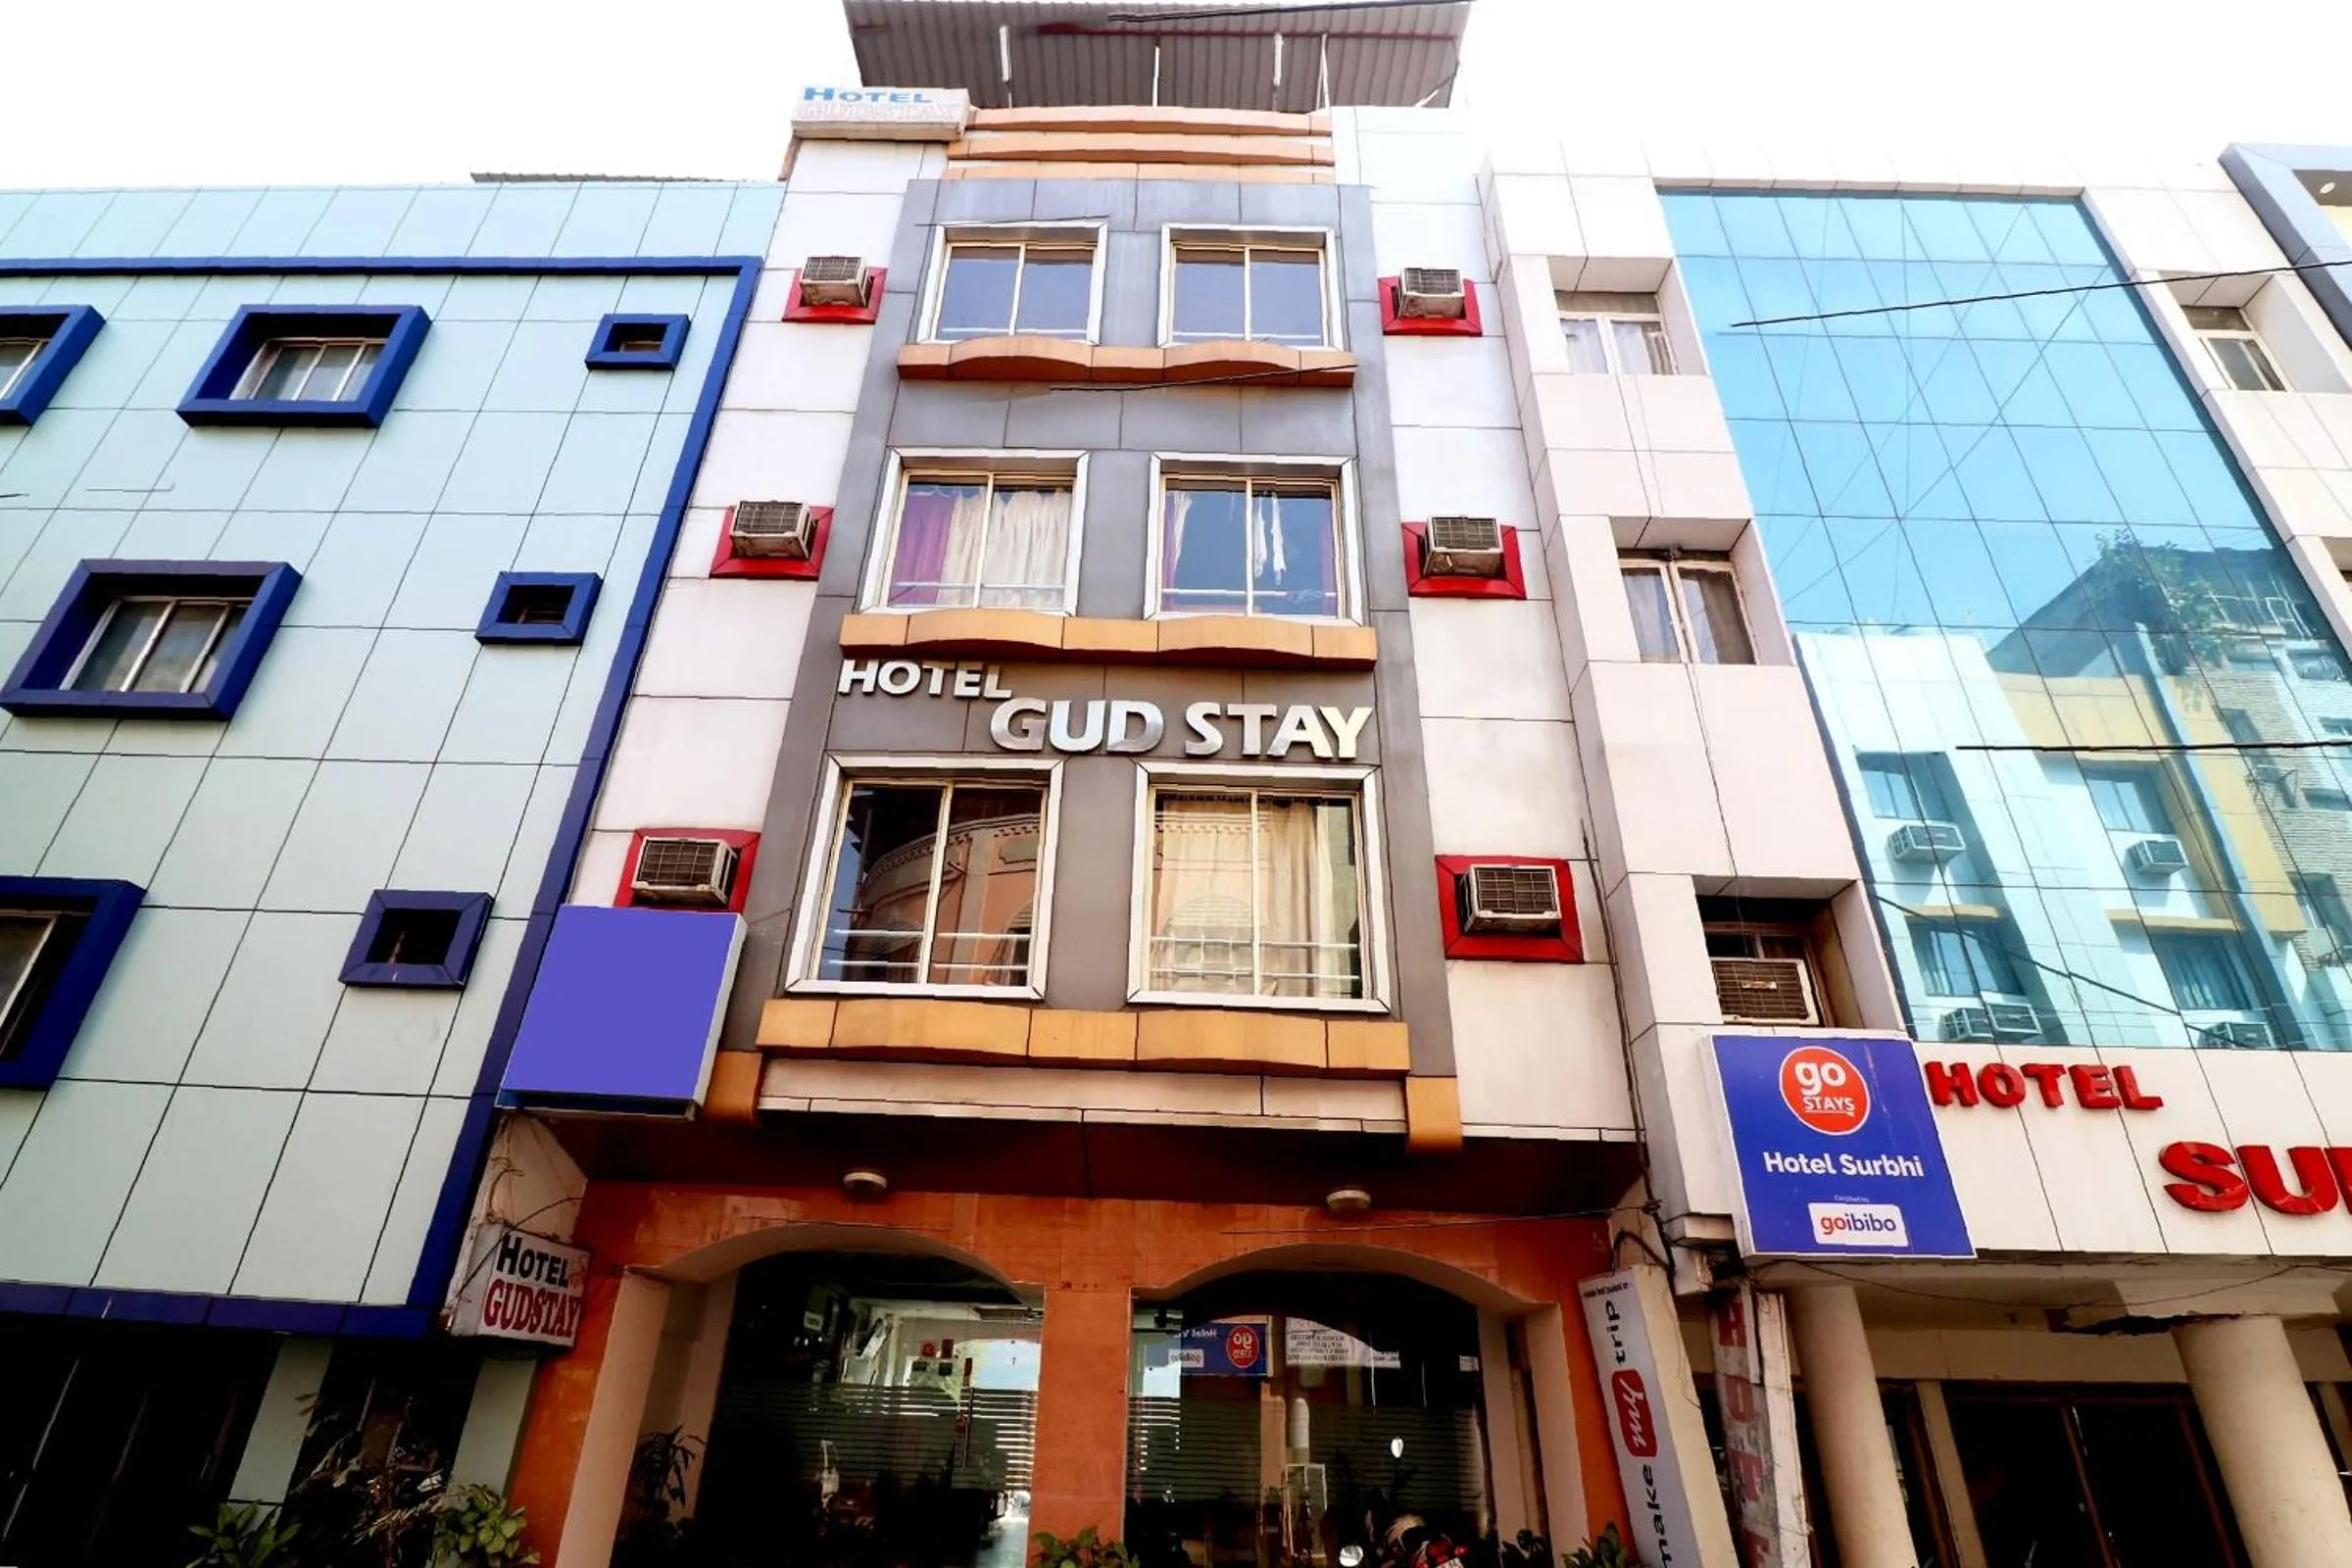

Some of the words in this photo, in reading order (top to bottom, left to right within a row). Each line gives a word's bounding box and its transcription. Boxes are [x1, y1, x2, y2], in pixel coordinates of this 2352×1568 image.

[804, 87, 932, 103] HOTEL
[837, 659, 1012, 699] HOTEL
[990, 697, 1165, 753] GUD
[1184, 702, 1373, 759] STAY
[1794, 1061, 1846, 1096] go
[1924, 1060, 2164, 1110] HOTEL
[1803, 1097, 1855, 1112] STAYS
[1763, 1152, 1837, 1175] Hotel
[1839, 1153, 1925, 1176] Surbhi
[1821, 1213, 1897, 1235] goibibo
[496, 1233, 569, 1289] HOTEL
[484, 1278, 582, 1339] GUDSTAY
[1605, 1299, 1627, 1366] trip
[1619, 1377, 1647, 1449] my
